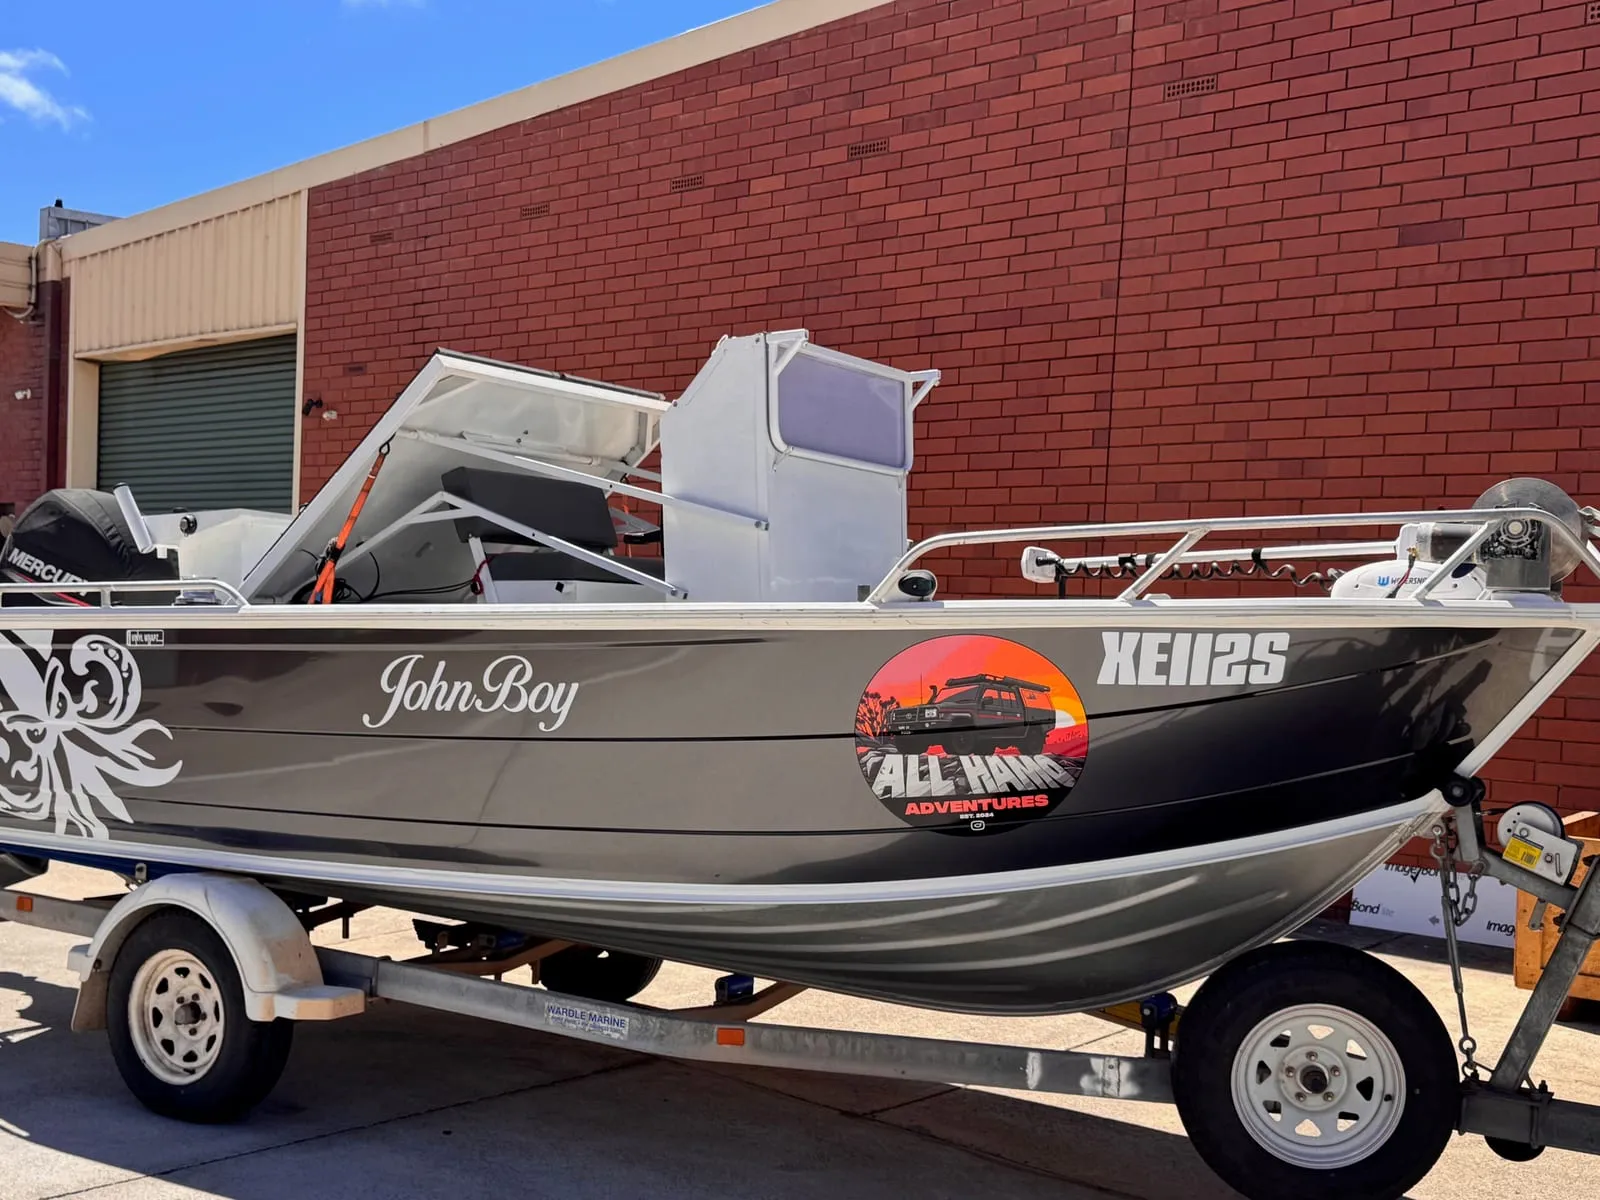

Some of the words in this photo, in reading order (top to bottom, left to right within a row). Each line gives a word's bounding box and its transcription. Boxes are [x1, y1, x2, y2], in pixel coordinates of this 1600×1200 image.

[871, 754, 956, 799] ALL
[905, 794, 1049, 815] ADVENTURES
[1351, 900, 1380, 914] Bond
[547, 1004, 586, 1020] WARDLE
[588, 1013, 625, 1028] MARINE
